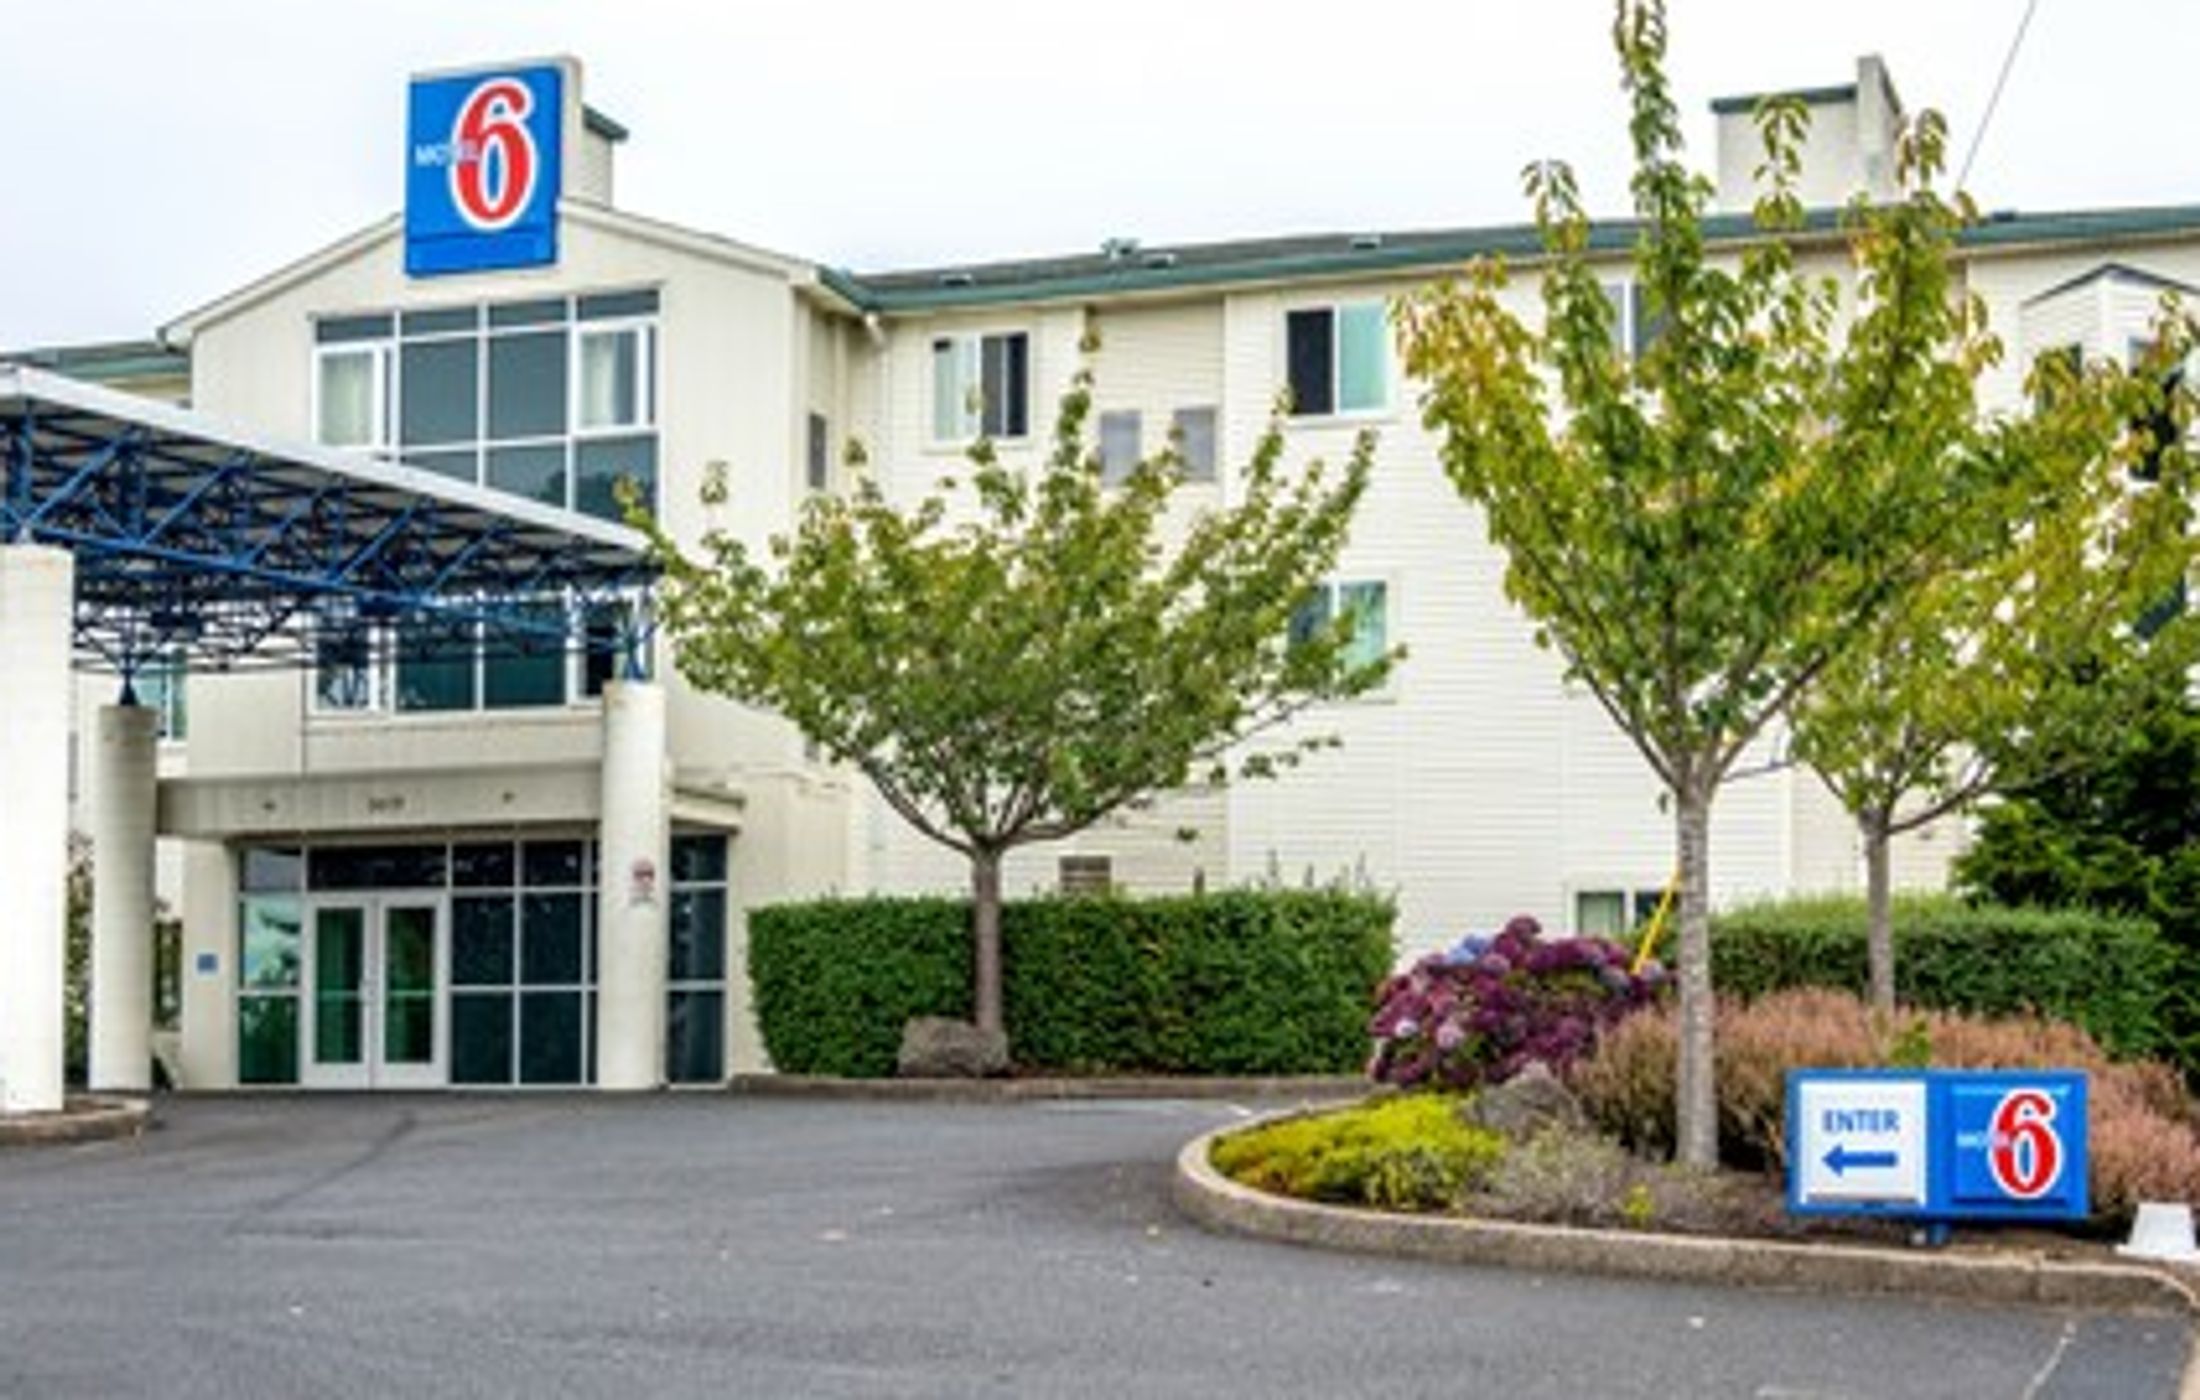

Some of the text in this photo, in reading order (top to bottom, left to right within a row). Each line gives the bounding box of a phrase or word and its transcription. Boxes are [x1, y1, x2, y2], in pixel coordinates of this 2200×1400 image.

[448, 77, 539, 231] 6
[1822, 1109, 1900, 1133] ENTER
[1987, 1088, 2063, 1198] 6
